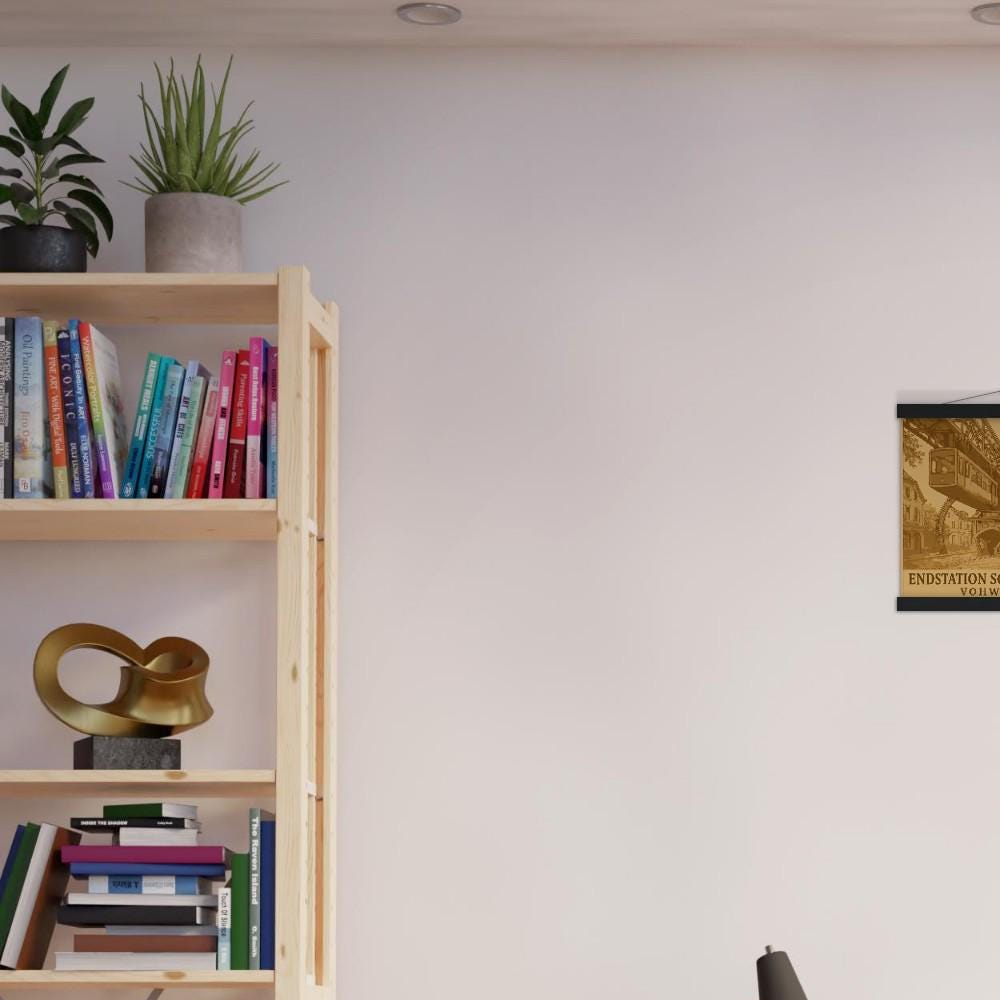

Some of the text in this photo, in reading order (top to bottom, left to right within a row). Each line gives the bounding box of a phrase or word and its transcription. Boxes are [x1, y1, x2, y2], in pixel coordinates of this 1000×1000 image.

[19, 335, 33, 396] Oil Paintings
[48, 356, 57, 374] FINE
[81, 336, 96, 384] Watercolor
[89, 385, 102, 422] Portraits
[49, 374, 58, 390] ART
[60, 354, 76, 420] ICONIC
[74, 369, 83, 395] Beauty
[77, 405, 85, 419] ART
[235, 374, 247, 427] Parenting Skills
[50, 413, 61, 436] Digital
[146, 408, 161, 459] SUCCESSFUL
[82, 452, 91, 485] NORMAN
[908, 572, 987, 585] ENDSTATION
[251, 816, 259, 905] The Raven Island
[220, 893, 229, 909] Touch
